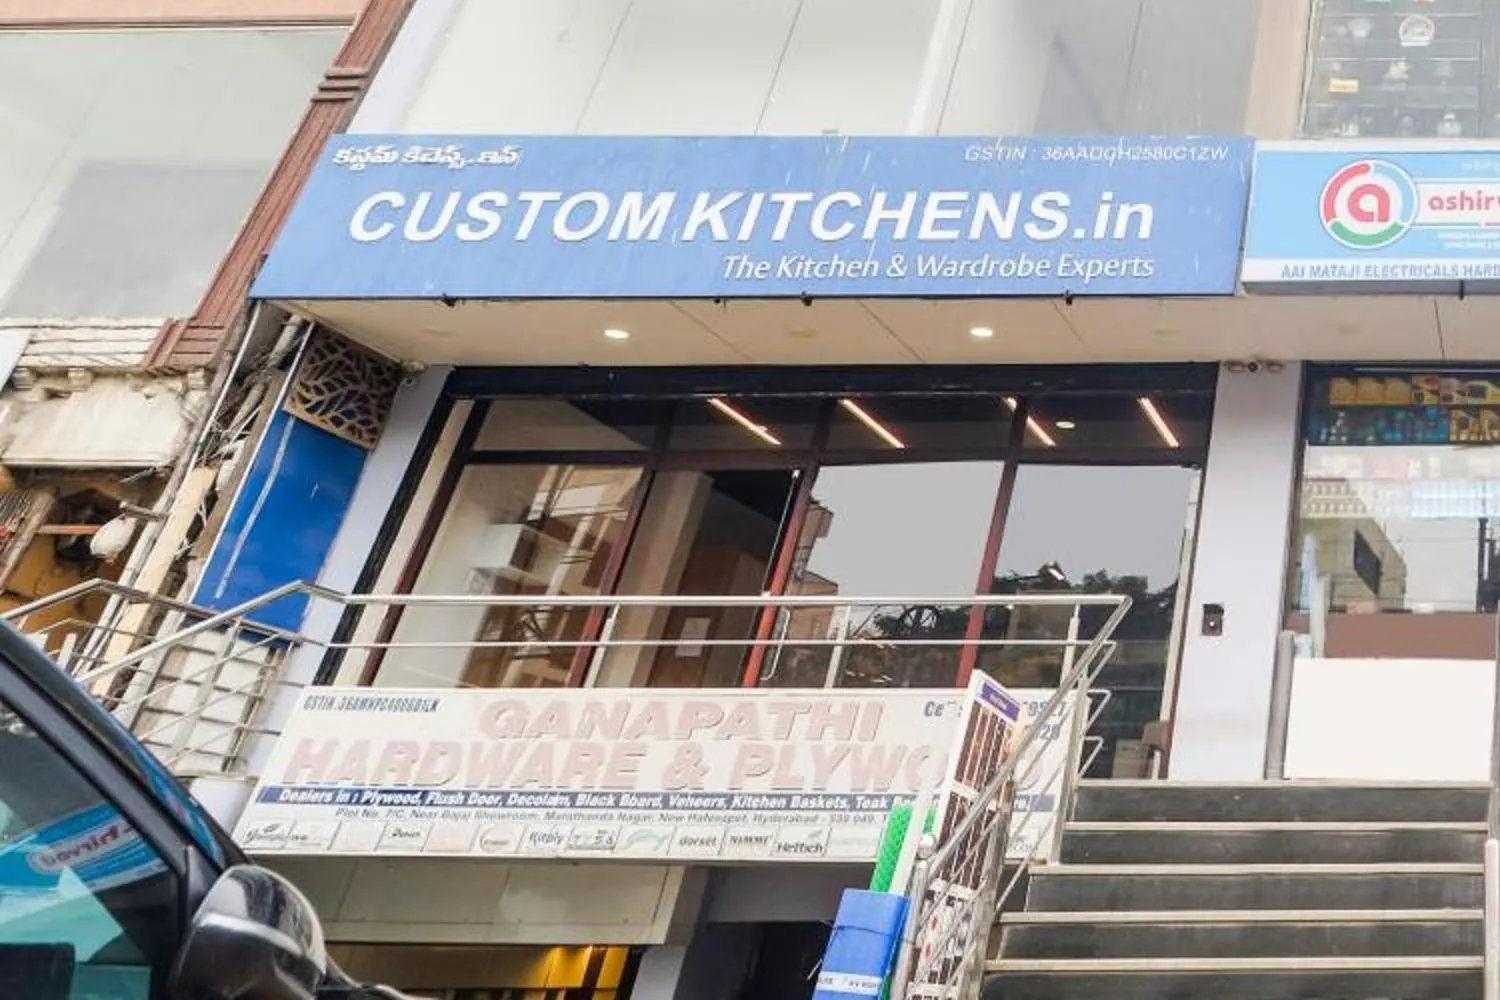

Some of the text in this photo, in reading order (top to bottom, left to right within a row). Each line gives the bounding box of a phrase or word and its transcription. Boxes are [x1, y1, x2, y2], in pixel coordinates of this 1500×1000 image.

[722, 254, 1155, 284] The Kitchen & Wardrobe Experts
[1280, 264, 1305, 279] AAI
[1309, 263, 1361, 279] MATAJI
[1363, 263, 1460, 279] ELECTRICALS
[478, 698, 887, 742] GANAPATHI
[280, 737, 650, 788] HARDWARE
[660, 742, 711, 791] &
[279, 789, 333, 804] Dealers
[361, 790, 422, 807] Plywood,
[424, 791, 465, 805] Flush
[467, 792, 503, 807] Door,
[575, 794, 616, 807] Black
[730, 794, 787, 809] Kitchen
[789, 795, 850, 811] Baskets,
[855, 795, 888, 809] Teak
